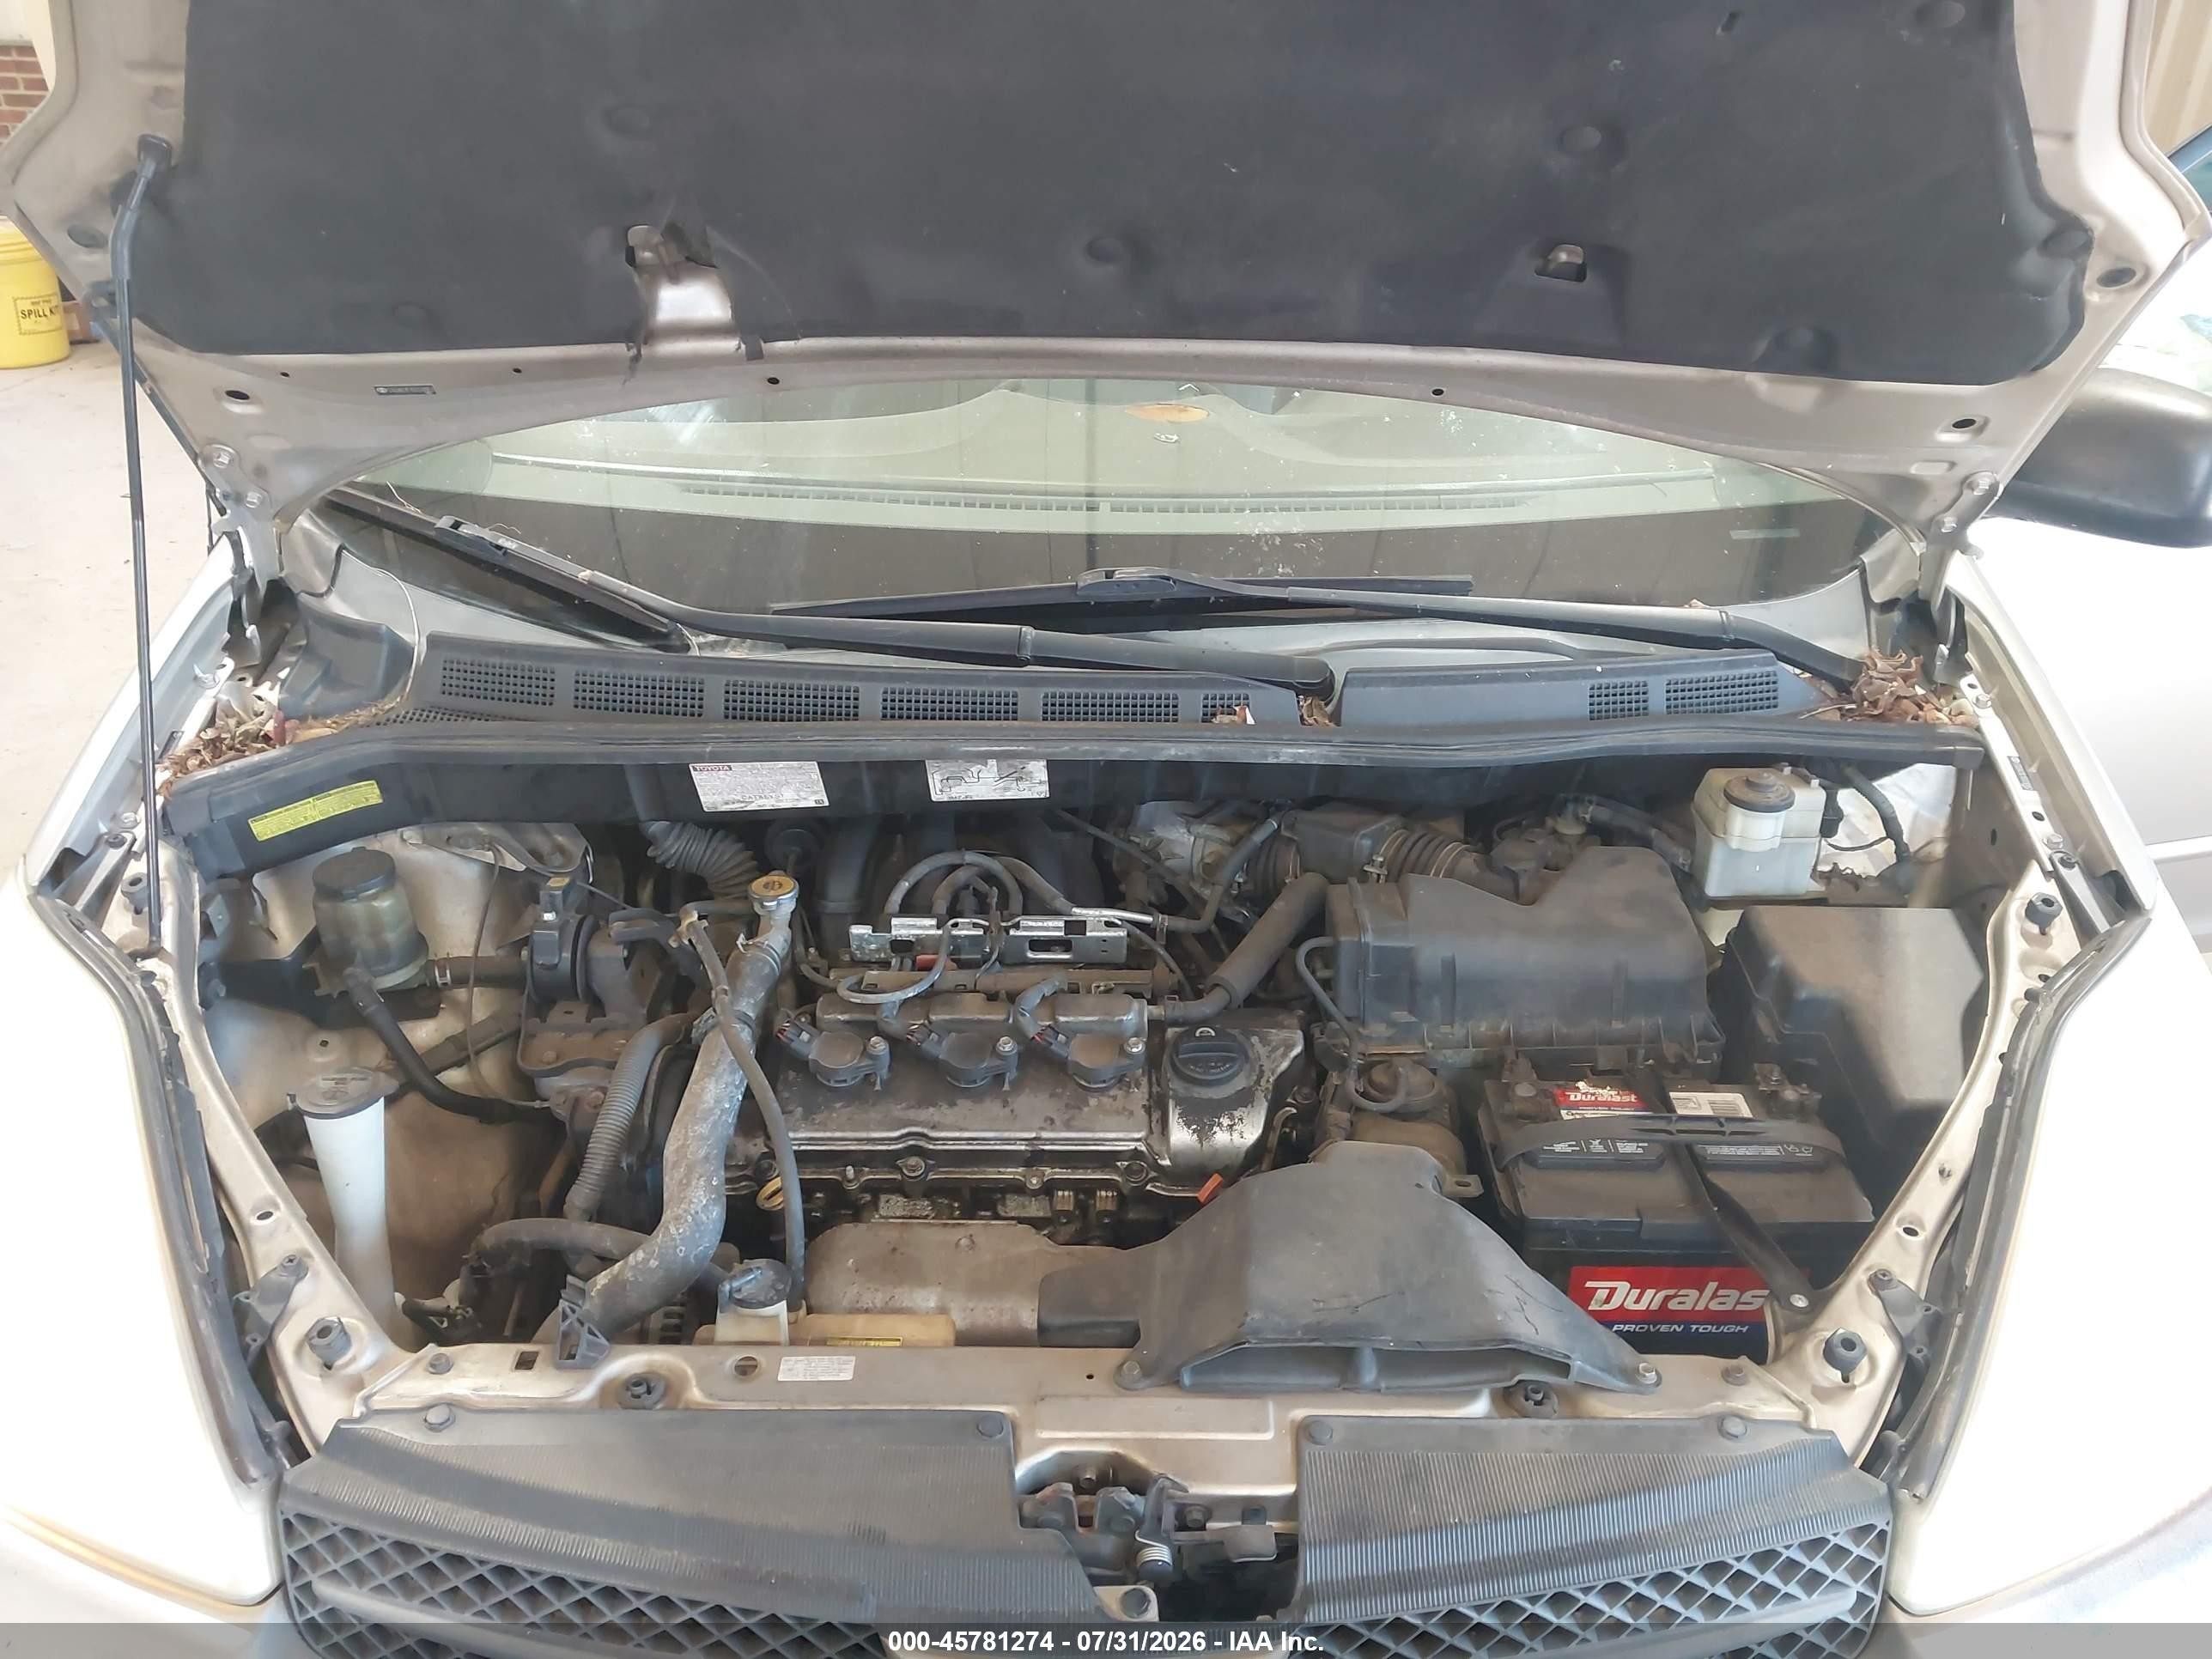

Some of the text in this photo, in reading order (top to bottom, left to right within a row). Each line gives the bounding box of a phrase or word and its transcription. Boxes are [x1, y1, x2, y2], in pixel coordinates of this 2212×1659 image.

[21, 308, 48, 319] SPILL
[1565, 1091, 1638, 1103] Duralast
[1584, 1280, 1771, 1311] Duralas
[1612, 1323, 1749, 1334] PROVEN TOUGH
